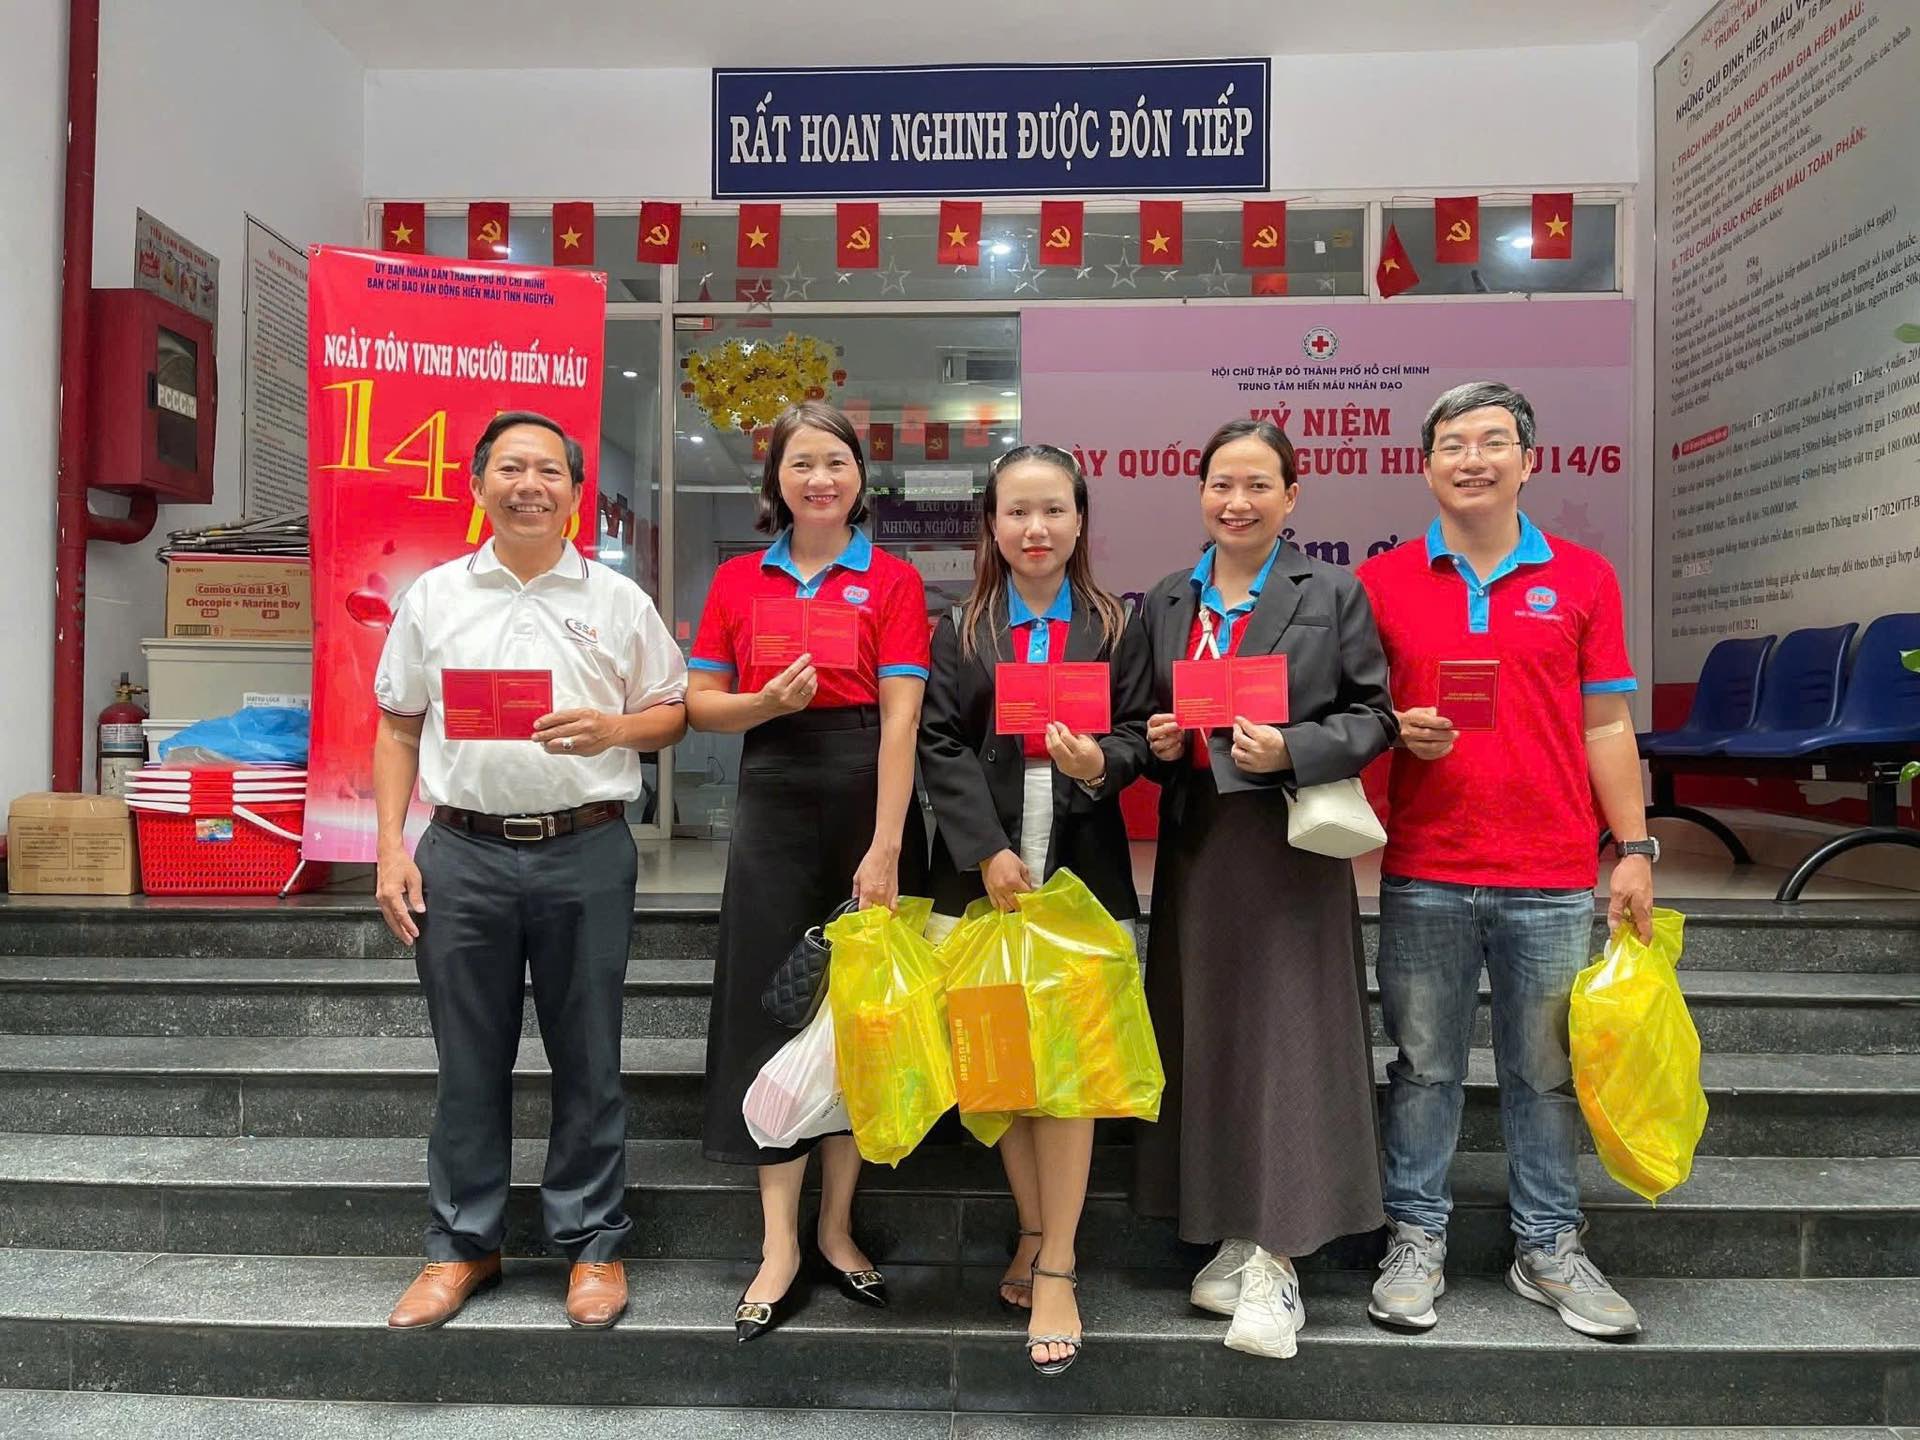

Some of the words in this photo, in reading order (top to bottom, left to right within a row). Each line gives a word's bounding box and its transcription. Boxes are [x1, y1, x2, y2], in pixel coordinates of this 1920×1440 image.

[1715, 19, 1739, 49] TRUNG
[1741, 0, 1757, 24] TÂM
[1676, 87, 1703, 122] NHỮNG
[1706, 70, 1720, 94] QUI
[1722, 50, 1743, 80] ĐỊNH
[1746, 26, 1768, 58] HIẾN
[1770, 4, 1792, 35] MÁU
[1678, 141, 1699, 167] TRÁCH
[1701, 120, 1723, 148] NHIỆM
[1726, 105, 1741, 127] CỦA
[1744, 82, 1768, 112] NGƯỜI
[1770, 60, 1793, 89] THAM
[1796, 45, 1811, 68] GIA
[1814, 24, 1836, 53] HIẾN
[730, 90, 791, 164] RẤT
[801, 113, 881, 162] HOAN
[891, 111, 1007, 161] NGHINH
[1018, 102, 1100, 171] ĐƯỢC
[1110, 94, 1172, 158] ĐÓN
[1183, 82, 1253, 156] TIẾP
[1679, 246, 1694, 265] TIÊU
[1696, 225, 1720, 254] CHUẨN
[1722, 216, 1737, 236] SỨC
[1740, 198, 1761, 223] KHỎE
[1764, 184, 1783, 207] HIẾN
[1786, 168, 1805, 192] MÁU
[1808, 149, 1832, 176] TOÀN
[367, 277, 384, 289] BAN
[386, 277, 400, 291] CHỈ
[402, 281, 417, 294] ĐẠO
[420, 282, 436, 296] VẬN
[438, 283, 460, 298] ĐỘNG
[462, 283, 481, 298] HIẾN
[503, 288, 521, 302] TÌNH
[523, 291, 554, 308] NGUYỆN
[388, 264, 404, 275] BAN
[524, 278, 545, 290] MINH
[324, 327, 371, 369] NGÀY
[374, 331, 409, 373] TÔN
[412, 342, 451, 377] VINH
[456, 340, 507, 381] NGƯỜI
[510, 338, 549, 385] HIẾN
[552, 347, 588, 387] MÁU
[1211, 366, 1229, 378] HỘI
[1233, 365, 1254, 376] CHỮ
[1257, 366, 1282, 378] THẬP
[1285, 364, 1300, 376] ĐỎ
[1304, 364, 1336, 376] THÀNH
[1340, 363, 1361, 375] PHỐ
[1364, 363, 1379, 375] HỒ
[1382, 364, 1401, 375] CHÍ
[1404, 366, 1429, 375] MINH
[1238, 381, 1271, 391] TRUNG
[1274, 380, 1295, 391] TÂM
[1298, 379, 1319, 390] HIẾN
[1323, 379, 1345, 390] MÁU
[1348, 380, 1377, 390] NHÂN
[1380, 381, 1403, 392] ĐẠO
[1303, 402, 1391, 443] NIỆM
[1072, 444, 1107, 477] ÀY
[1119, 440, 1200, 478] QUỐC
[1294, 441, 1367, 475] GƯỜI
[1381, 448, 1425, 475] HI
[186, 598, 232, 608] Chocopie
[242, 599, 279, 608] Marine
[281, 600, 300, 609] Boy
[198, 585, 231, 594] Combo
[267, 584, 288, 596] 1+1
[573, 622, 598, 641] SSA
